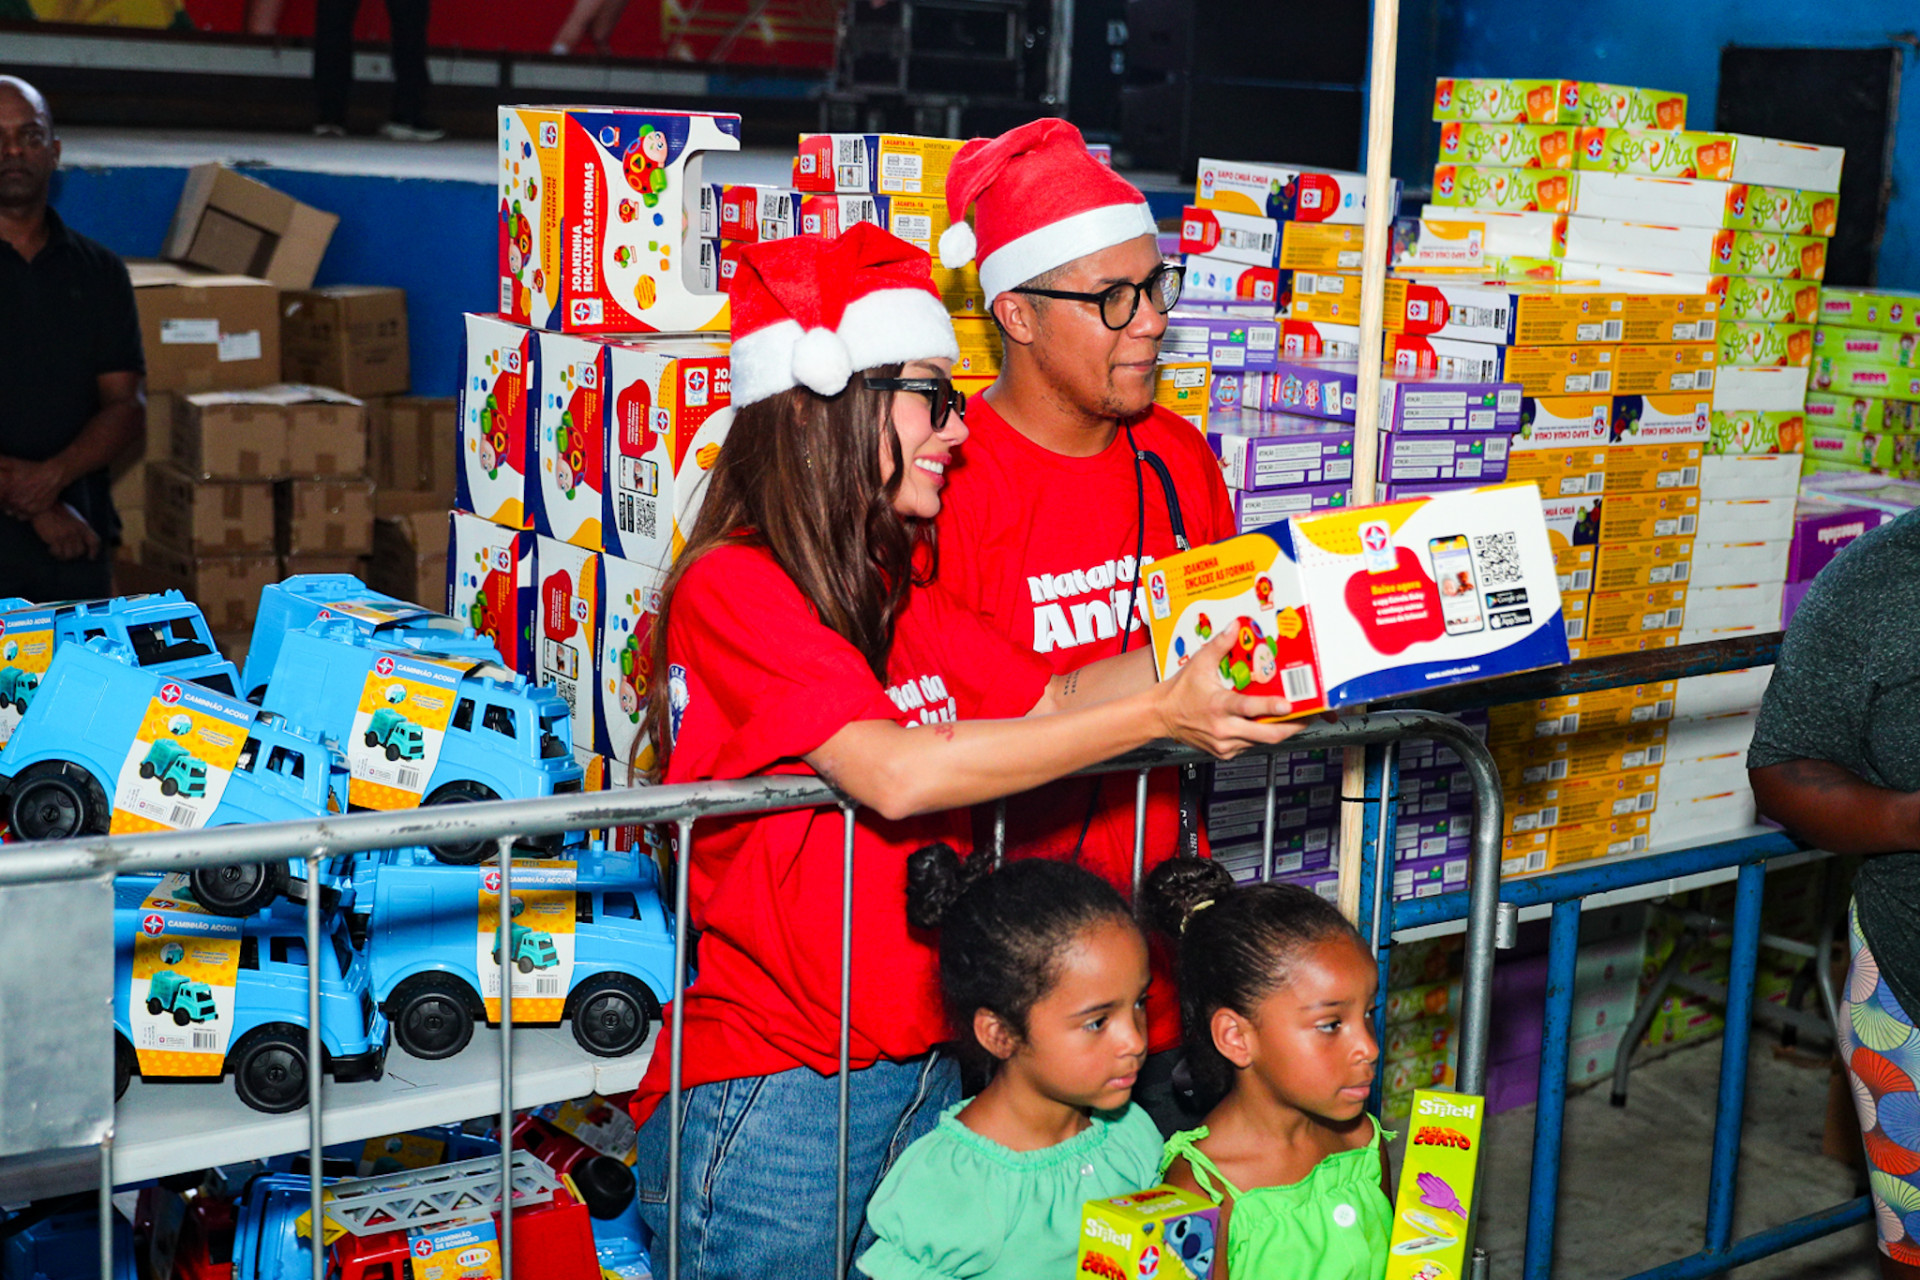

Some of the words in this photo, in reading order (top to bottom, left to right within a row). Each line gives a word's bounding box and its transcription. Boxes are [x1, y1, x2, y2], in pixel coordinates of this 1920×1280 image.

[584, 162, 595, 217] FORMAS
[583, 218, 594, 236] AS
[572, 224, 582, 292] JOANINHA
[583, 237, 594, 292] ENCAIXE
[1545, 506, 1558, 516] HUÁ
[1183, 557, 1218, 576] JOANINHA
[1185, 572, 1214, 590] ENCAIXE
[1216, 570, 1225, 580] AS
[1225, 560, 1256, 577] FORMAS
[1027, 560, 1116, 603] Natal
[397, 664, 432, 678] CAMINHÃO
[433, 673, 456, 684] ACQUA
[919, 675, 949, 703] da
[184, 693, 223, 711] CAMINHÃO
[223, 707, 249, 721] ACQUA
[168, 920, 209, 930] CAMINHÃO
[210, 924, 237, 932] ACQUA
[1414, 1132, 1471, 1150] CERTO
[434, 1231, 472, 1243] CAMINHÃO
[445, 1236, 479, 1247] BOMBEIRO
